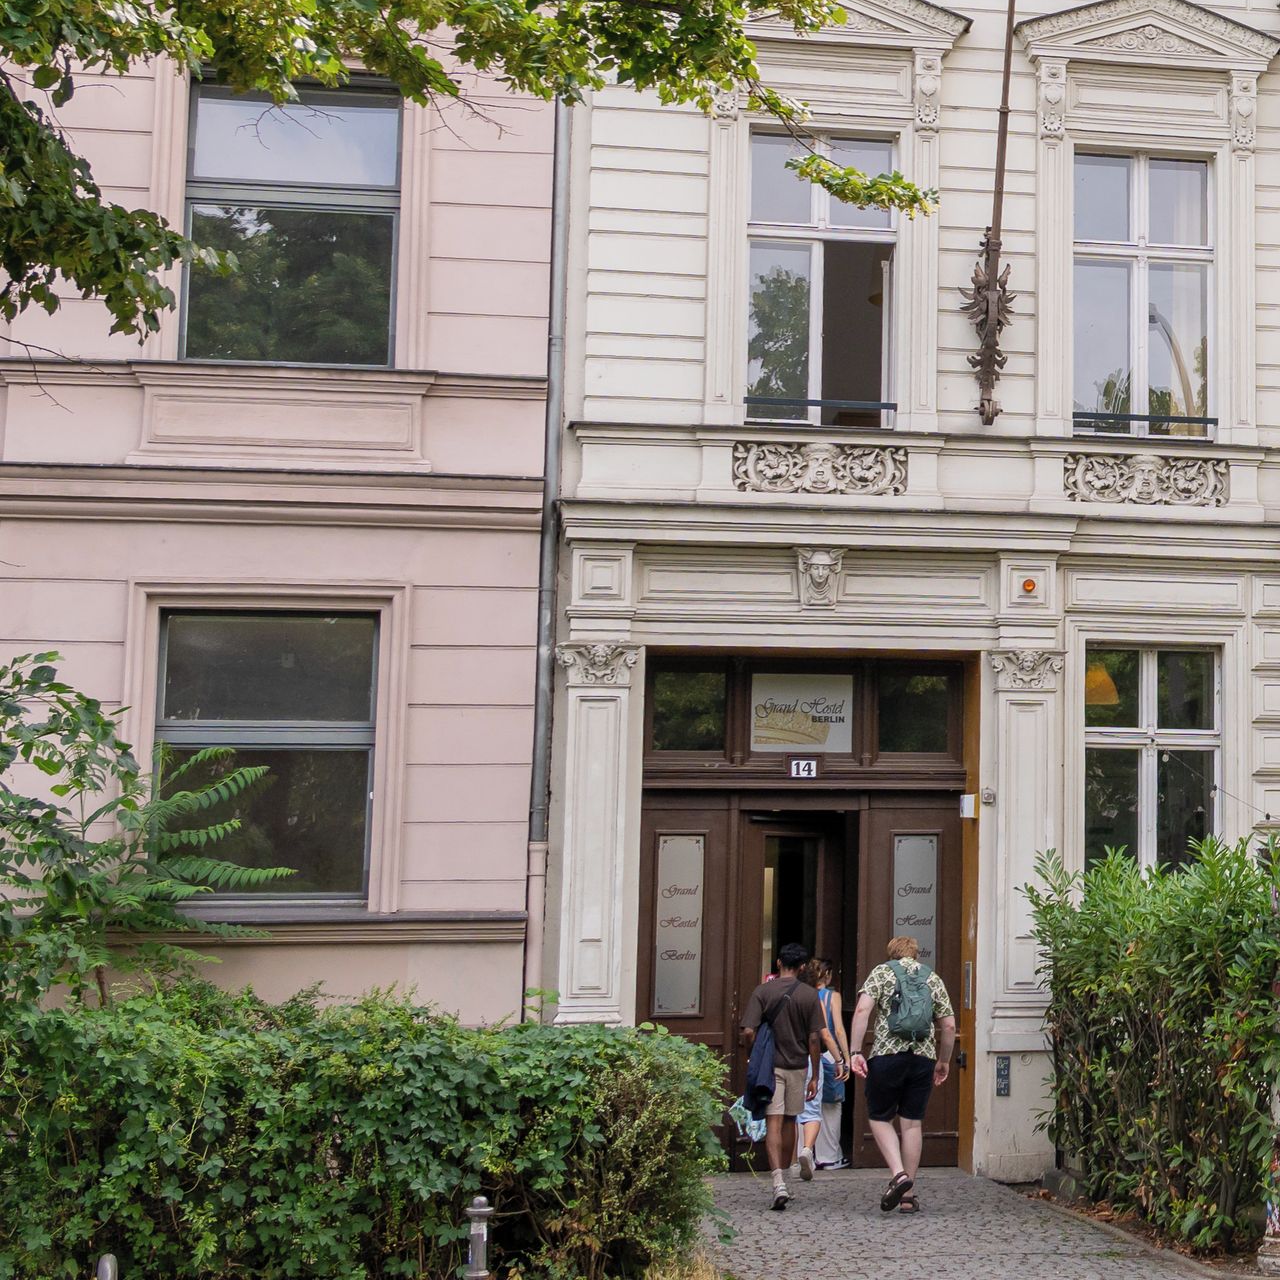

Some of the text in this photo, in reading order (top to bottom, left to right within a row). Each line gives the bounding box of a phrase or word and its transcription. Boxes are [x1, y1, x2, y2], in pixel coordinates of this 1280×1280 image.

[755, 697, 845, 719] Grand Hostel
[811, 715, 845, 723] BERLIN
[794, 762, 813, 776] 14
[661, 884, 699, 899] Grand
[897, 882, 933, 898] Grand
[660, 916, 699, 928] Hostel
[895, 914, 933, 926] Hostel
[660, 949, 697, 961] Berlin
